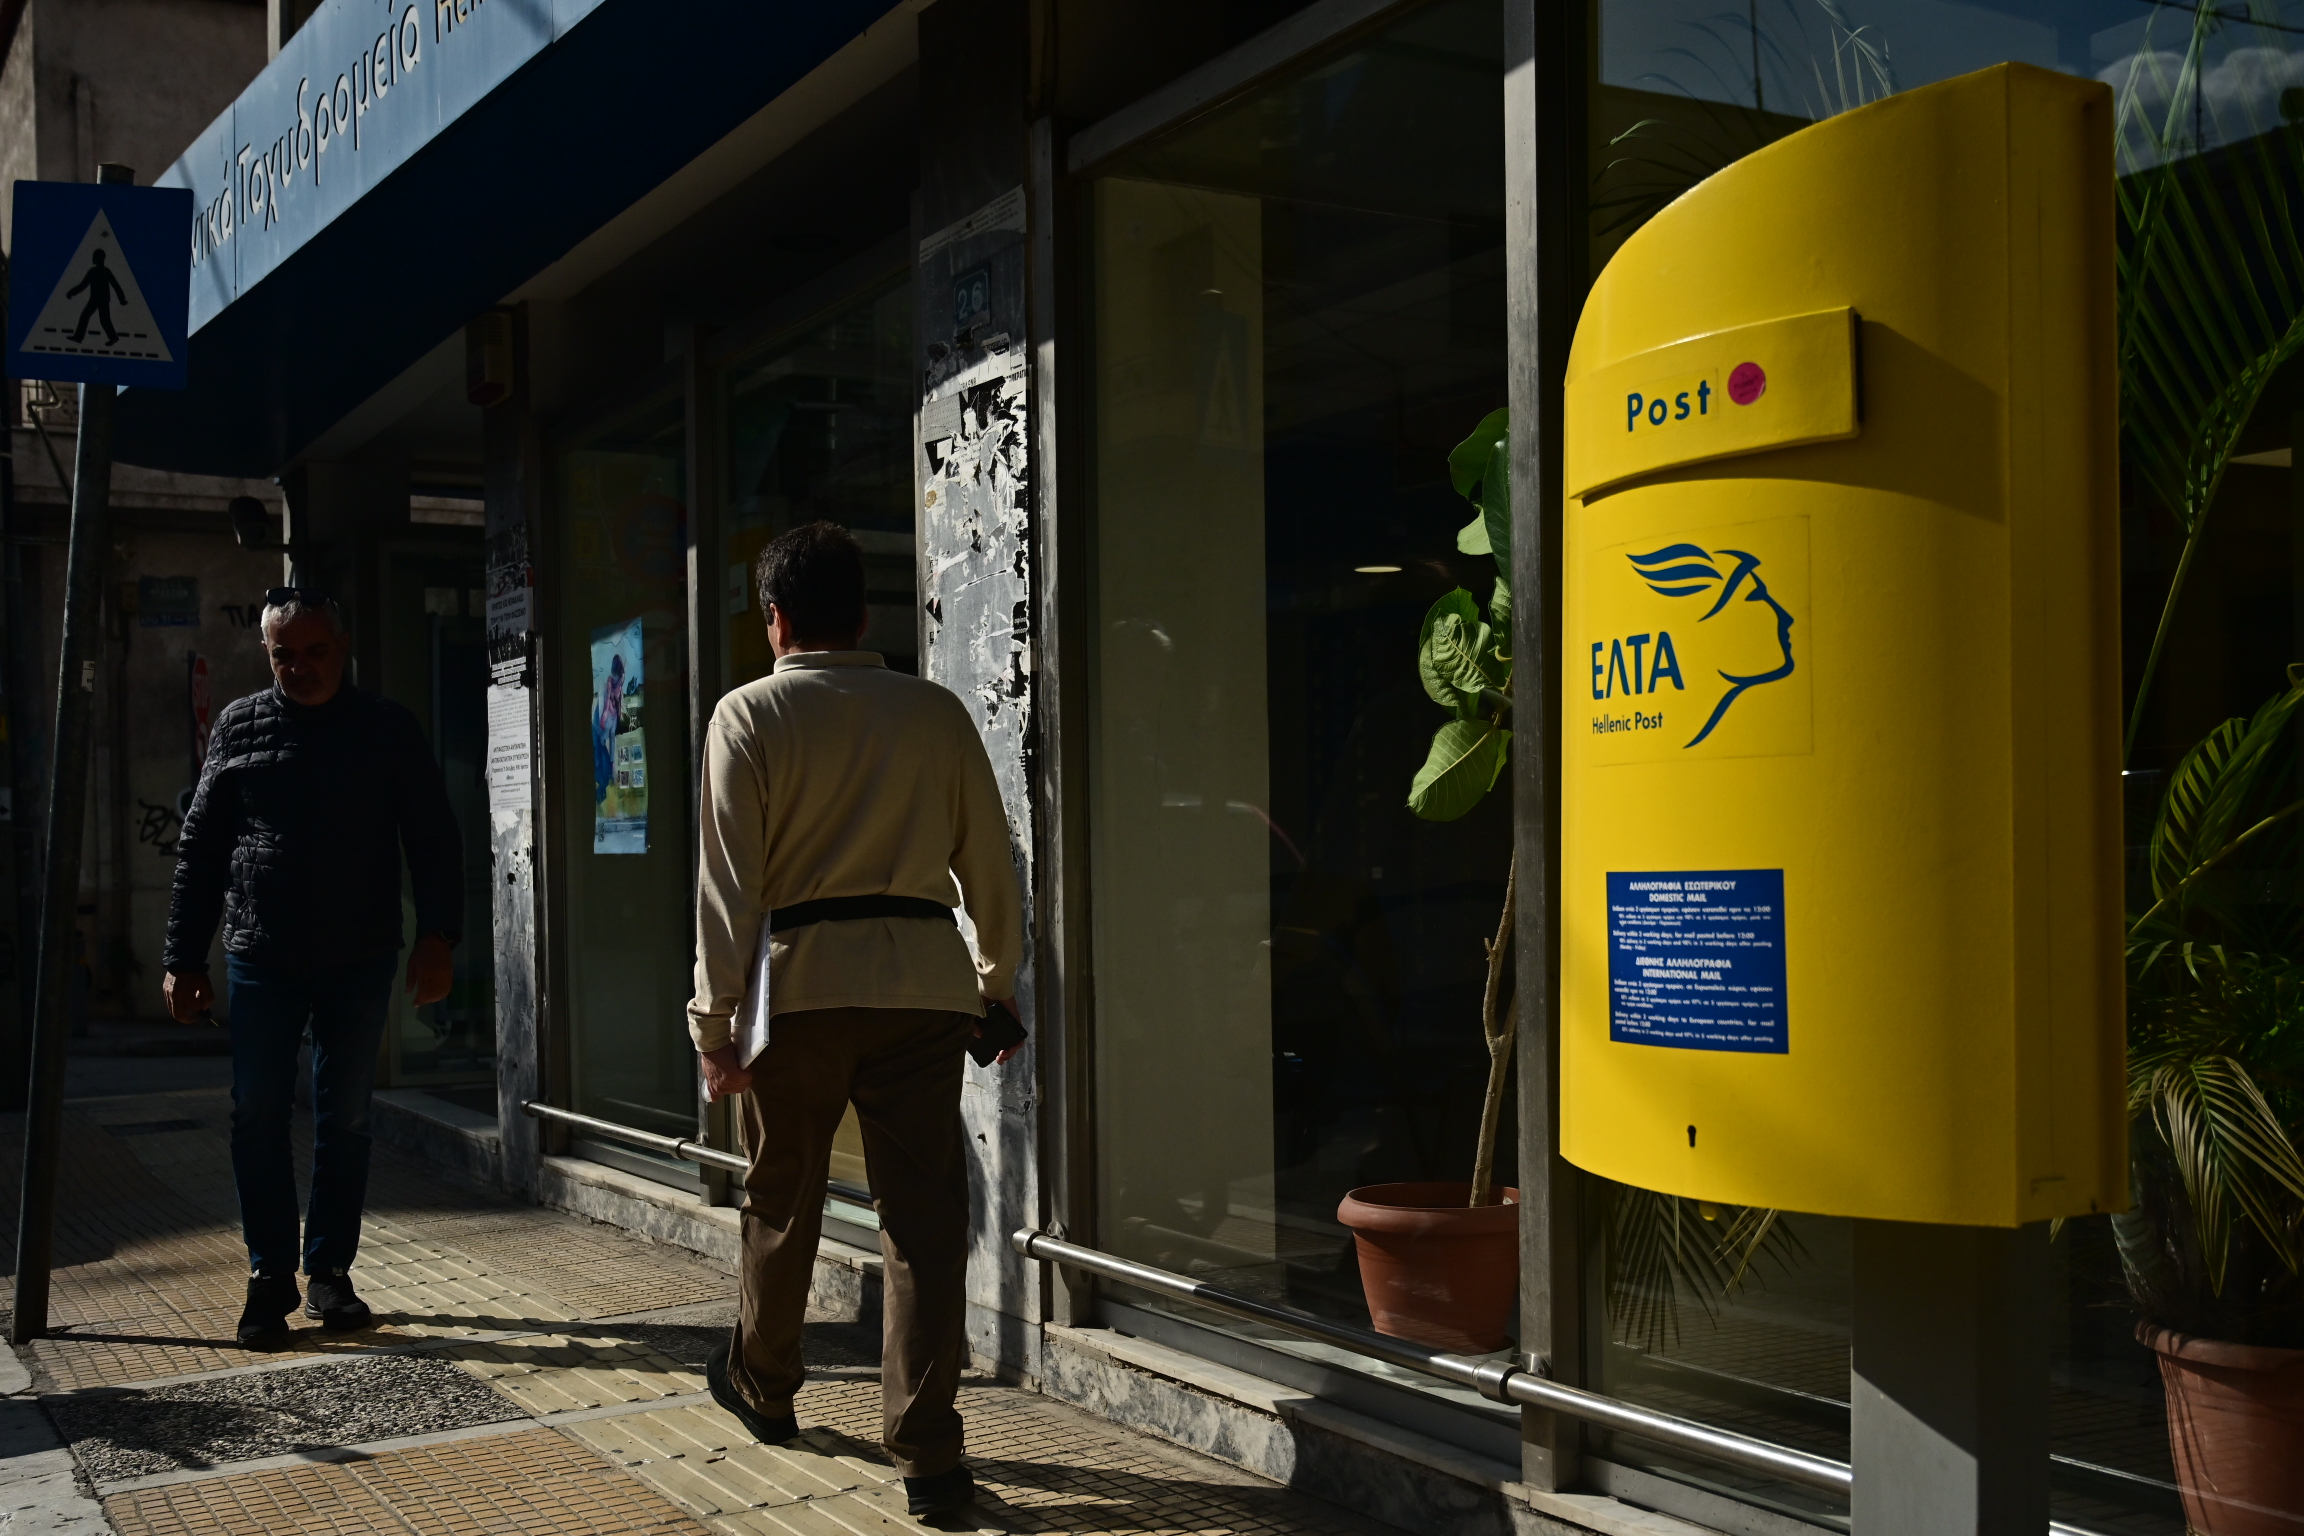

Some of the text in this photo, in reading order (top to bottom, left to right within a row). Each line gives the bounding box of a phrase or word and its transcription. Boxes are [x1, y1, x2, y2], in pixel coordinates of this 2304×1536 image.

[190, 0, 420, 268] νικά Ταχυδρομεία
[957, 280, 984, 320] 26
[1627, 380, 1711, 432] Post
[1591, 631, 1685, 700] ΕΛΤΑ
[192, 673, 208, 708] STOP
[1592, 711, 1662, 734] Hellenic Post
[1629, 881, 1736, 891] ΑΛΛΗΛΟΓΡΑΦΙΑ ΕΣΩΤΕΡΙΚΟΥ
[1649, 893, 1707, 902] DOMESTIC MAIL
[1636, 957, 1732, 969] ΔΙΕΘΝΗΣ ΑΛΛΗΛΟΓΡΑΦΙΑ
[1643, 969, 1722, 980] INTERNATIONAL MAIL
